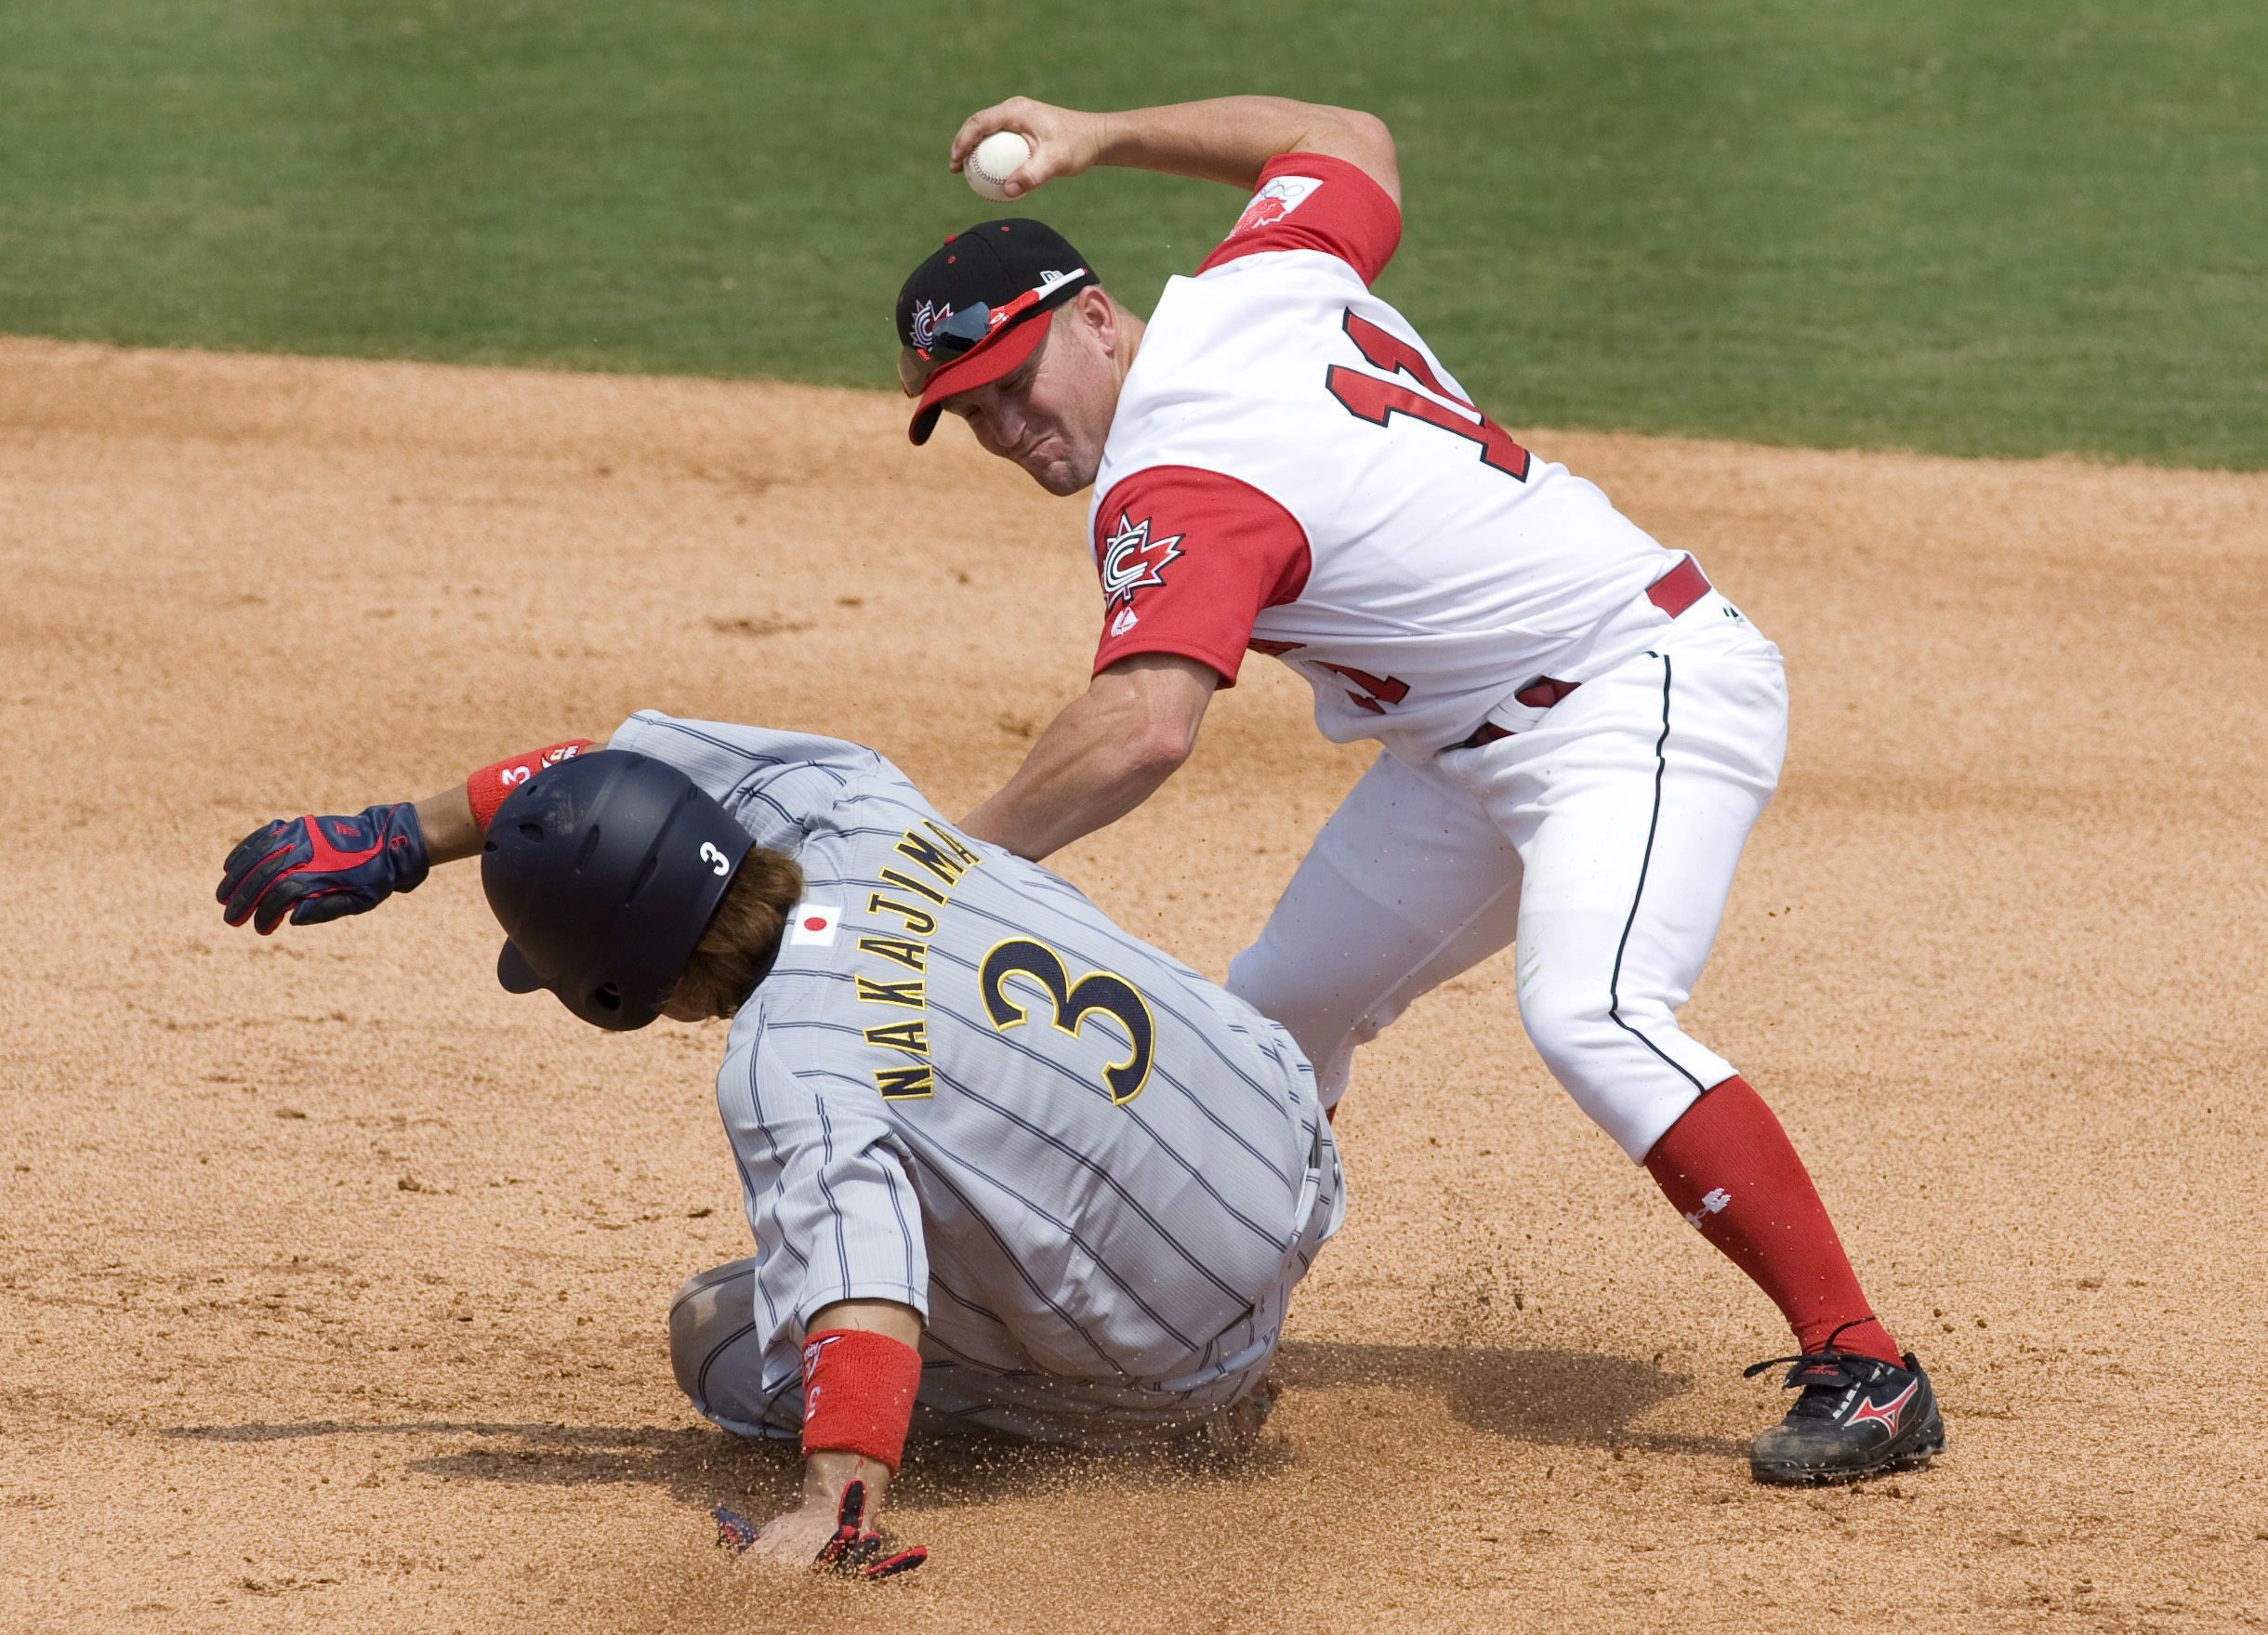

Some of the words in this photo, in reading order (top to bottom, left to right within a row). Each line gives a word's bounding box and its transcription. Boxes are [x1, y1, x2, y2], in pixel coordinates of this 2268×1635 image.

[1325, 306, 1530, 483] 11
[699, 841, 730, 877] 3
[853, 818, 982, 1101] NAKAJIMA
[978, 936, 1155, 1106] 3
